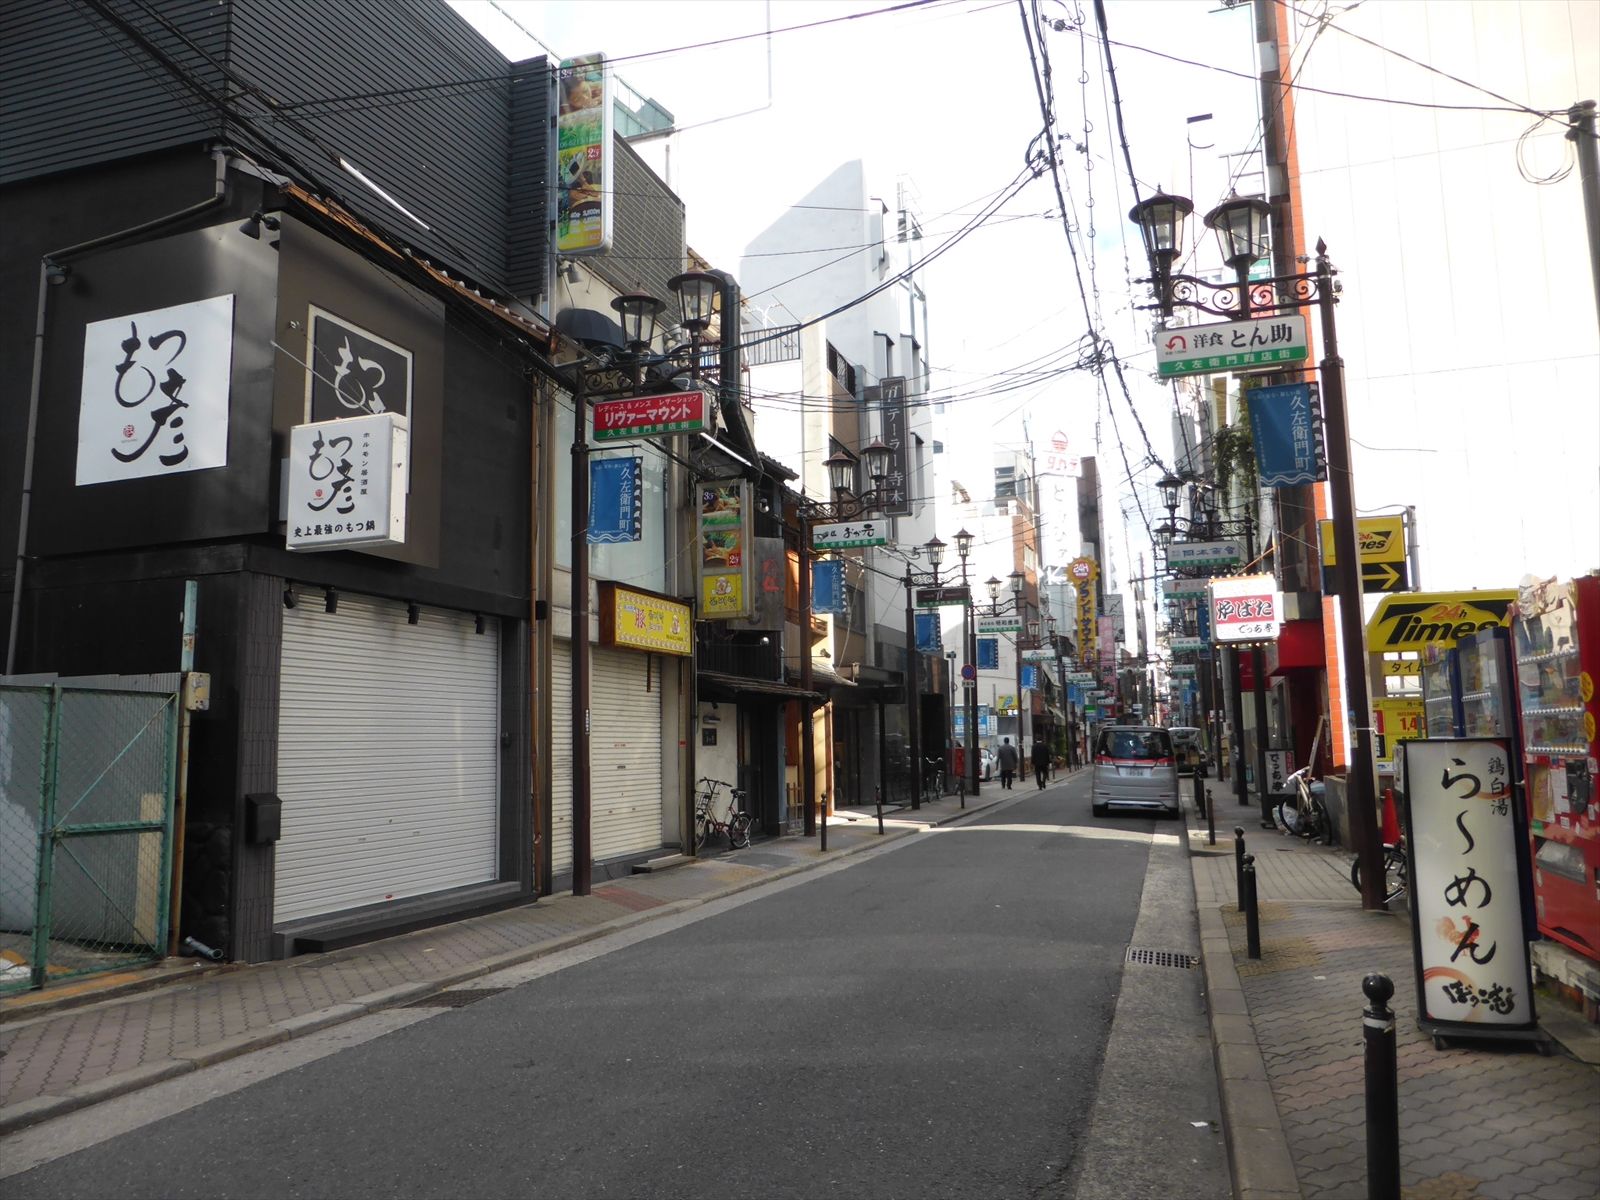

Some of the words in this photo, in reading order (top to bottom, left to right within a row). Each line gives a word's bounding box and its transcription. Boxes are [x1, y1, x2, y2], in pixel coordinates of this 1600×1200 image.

[1193, 331, 1223, 349] 洋食
[1231, 324, 1292, 348] とん助
[605, 404, 691, 427] リヴァーマウント
[1290, 394, 1311, 472] 久左衛門町
[360, 432, 370, 495] ホルモン居酒屋
[294, 520, 375, 537] 史上最強のもつ鍋
[619, 467, 631, 532] 久左衛門町
[1487, 757, 1508, 817] 鶏白湯
